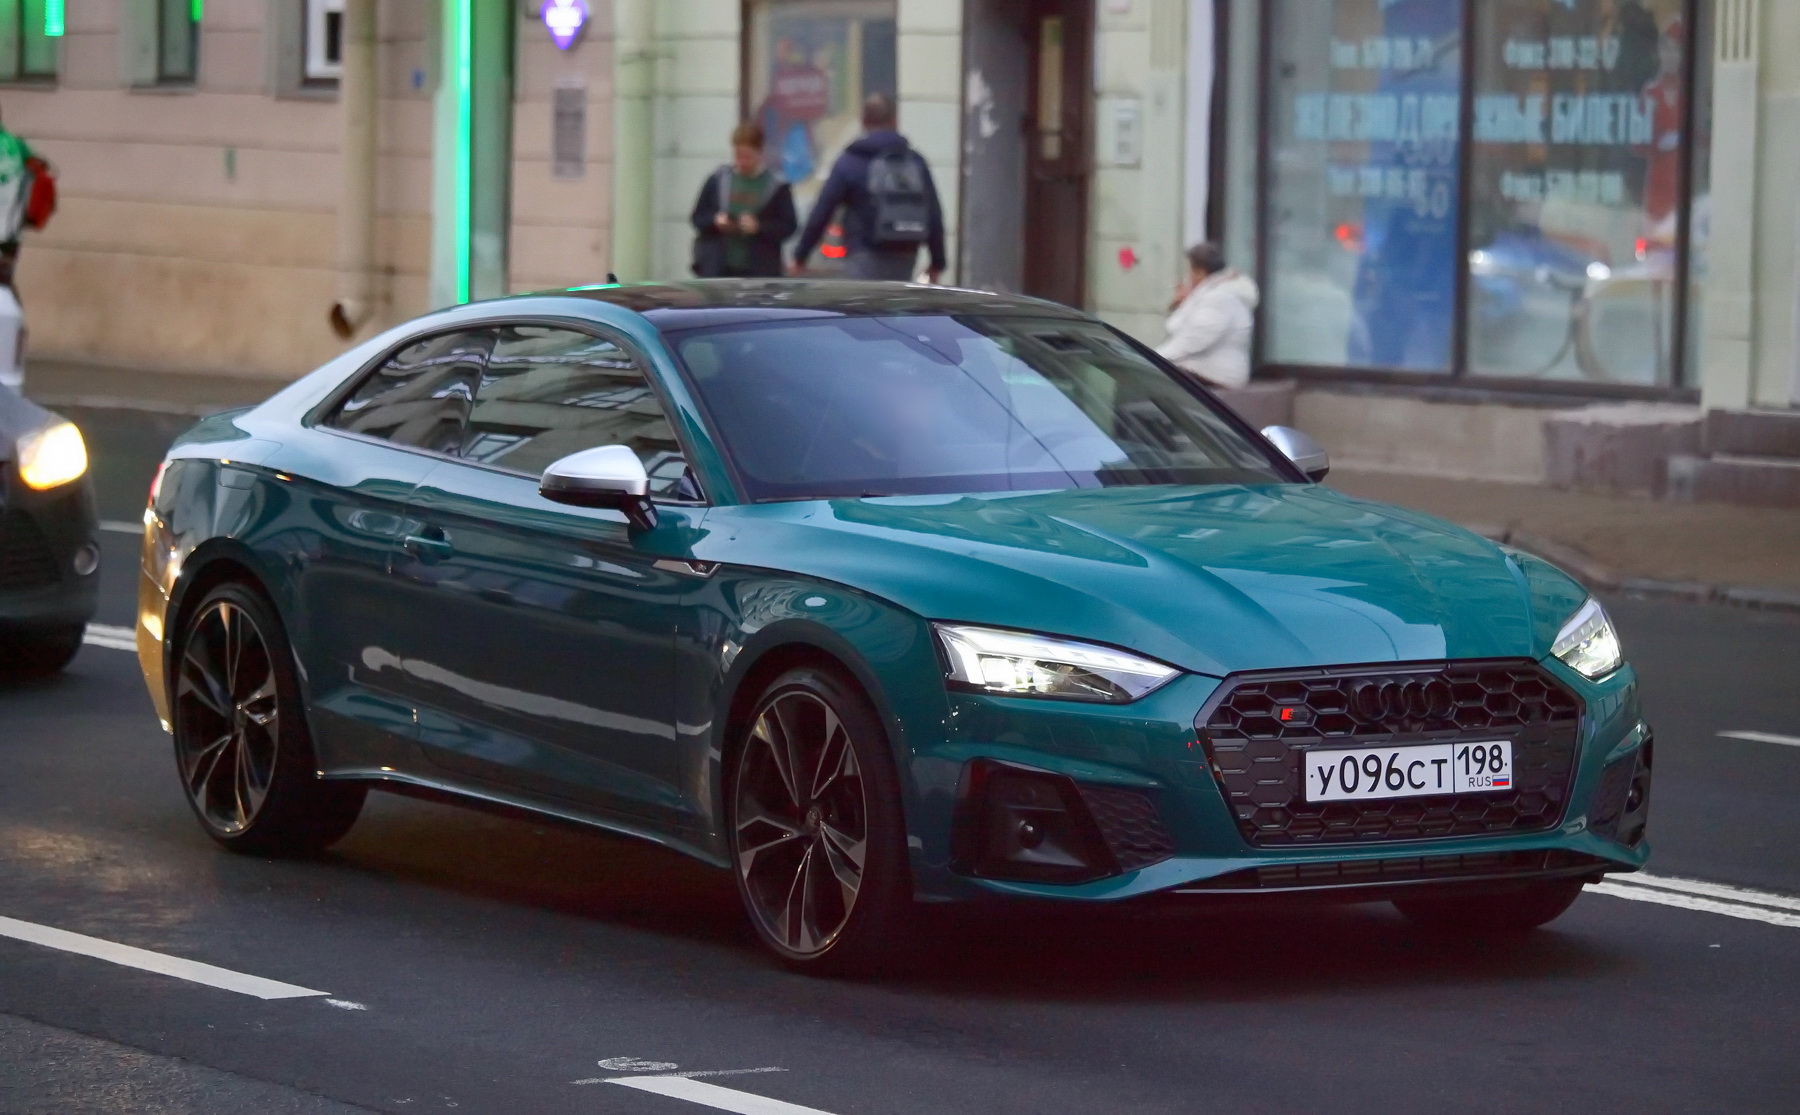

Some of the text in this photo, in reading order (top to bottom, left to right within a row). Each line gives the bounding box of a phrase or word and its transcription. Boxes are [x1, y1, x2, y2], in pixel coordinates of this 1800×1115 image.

[1551, 94, 1655, 144] БИЛЕТЫ
[1317, 752, 1448, 796] У096СТ
[1456, 744, 1504, 776] 198
[1468, 776, 1492, 788] RUS
